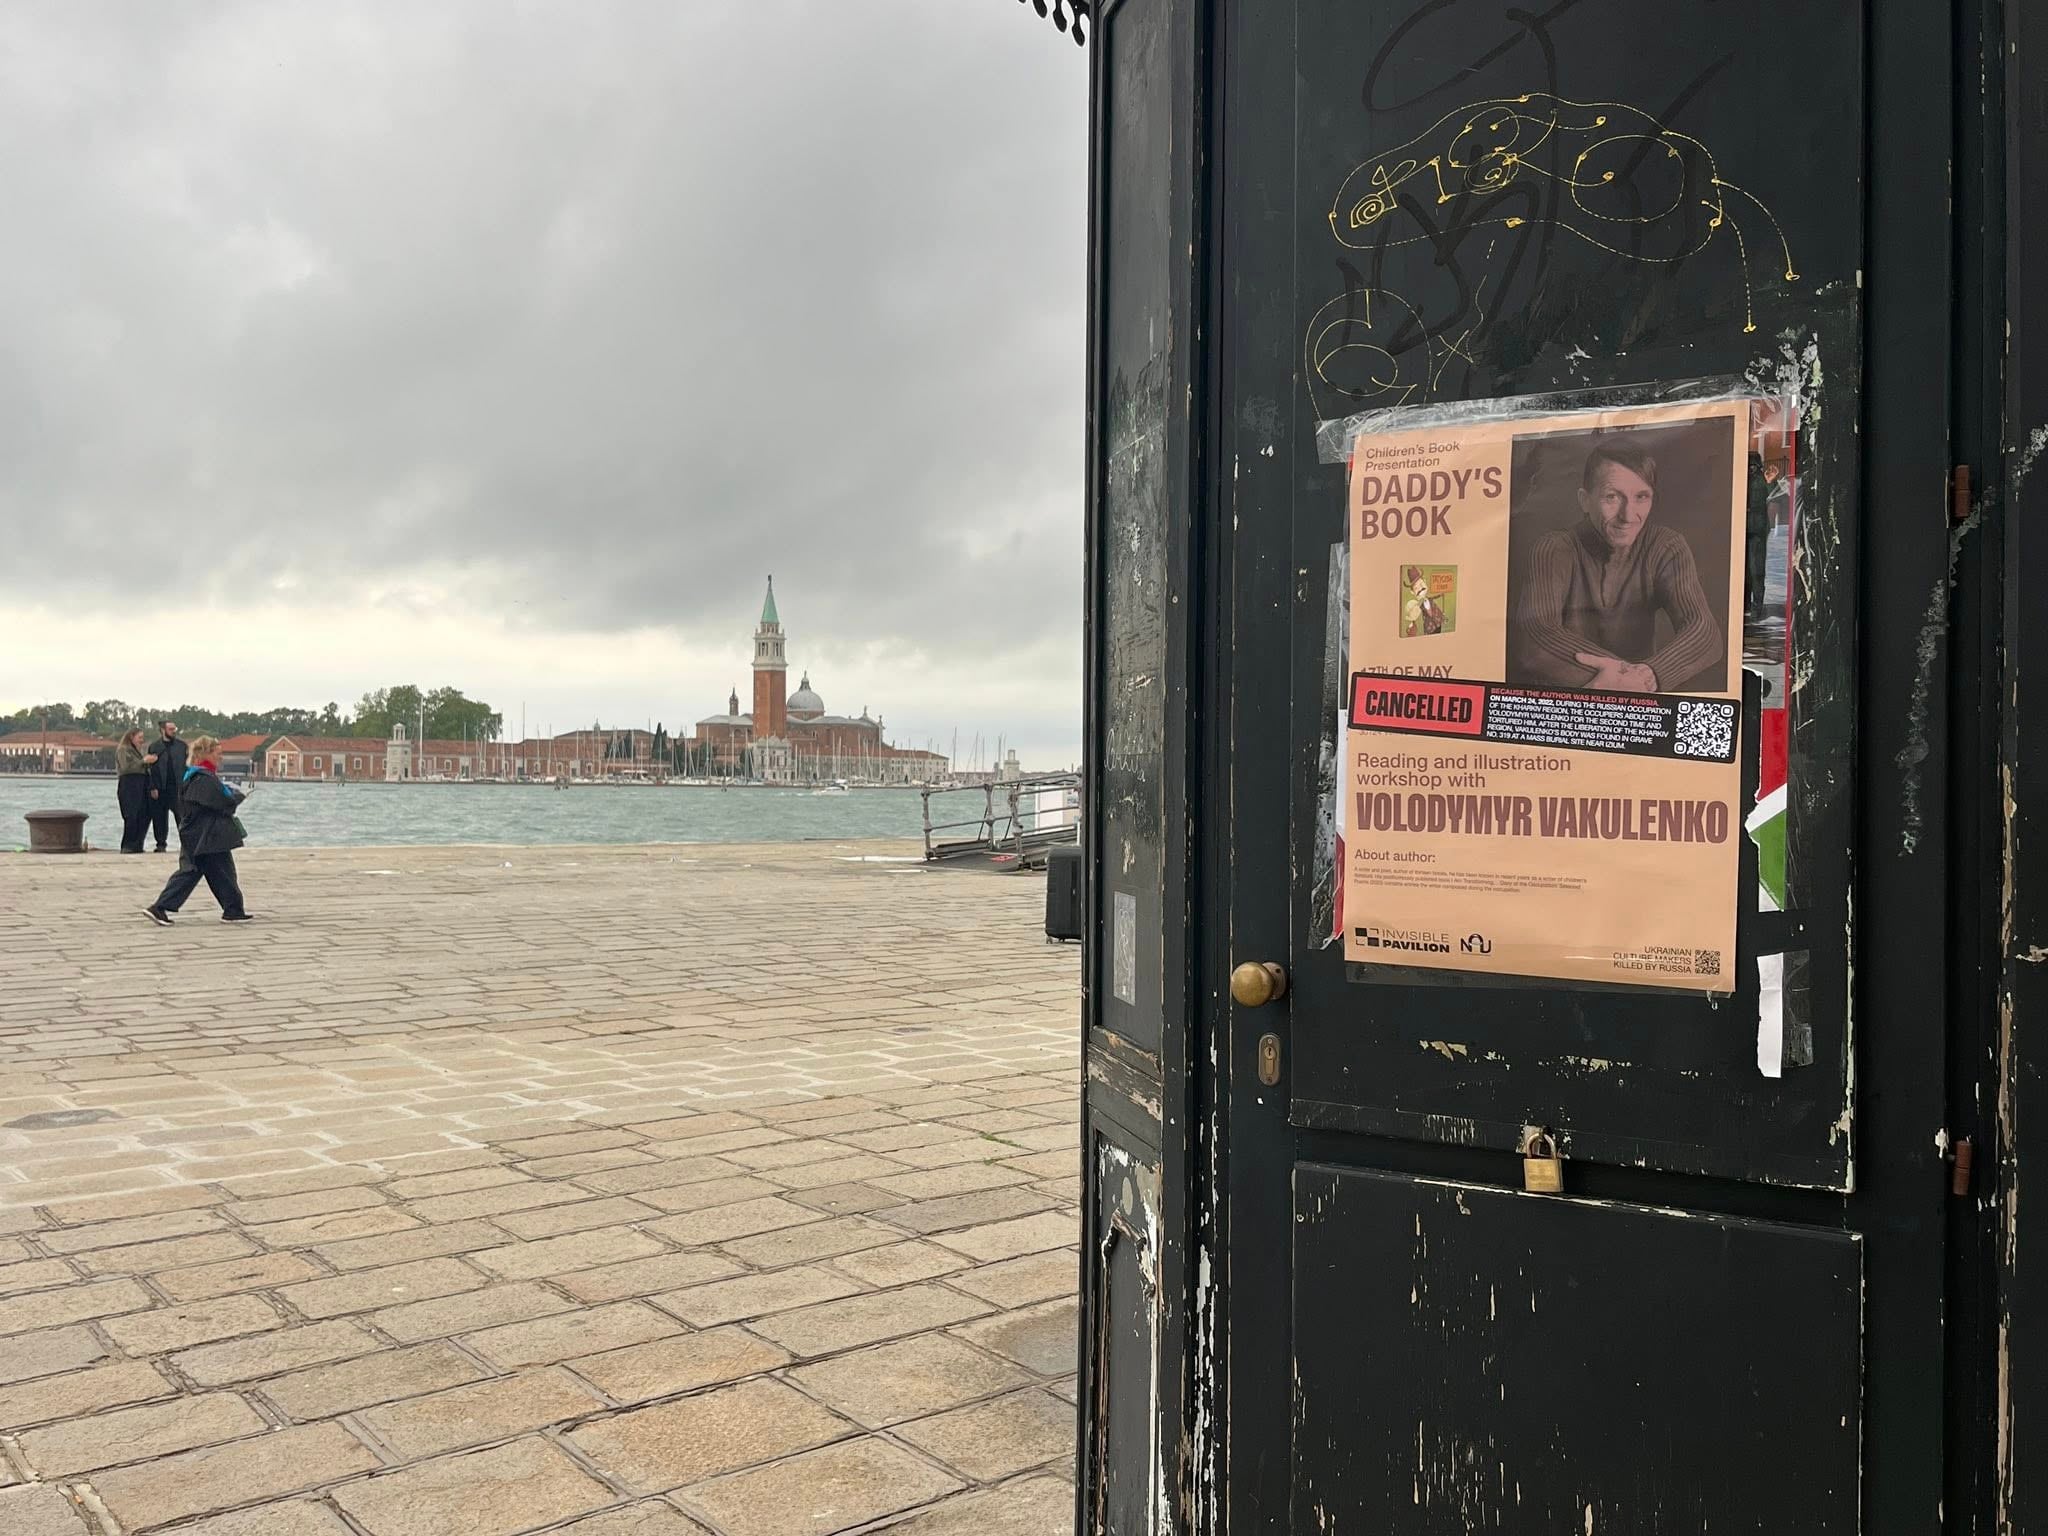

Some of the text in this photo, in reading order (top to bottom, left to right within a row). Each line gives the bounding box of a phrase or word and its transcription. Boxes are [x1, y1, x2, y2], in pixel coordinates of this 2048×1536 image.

[1367, 441, 1460, 458] Children's Book
[1366, 458, 1440, 472] Presentation
[1362, 466, 1502, 506] DADDY'S
[1362, 505, 1452, 539] BOOK
[1419, 666, 1453, 678] MAY
[1491, 688, 1525, 696] BECAUSE
[1541, 692, 1572, 700] AUTHOR
[1630, 698, 1659, 706] RUSSIA.
[1366, 690, 1472, 723] CANCELLED
[1556, 700, 1581, 708] DURING
[1596, 703, 1626, 711] RUSSIAN
[1627, 706, 1671, 715] OCCUPATION
[1489, 709, 1530, 718] VOLODYMYR
[1530, 712, 1569, 722] VAKULENKO
[1600, 718, 1628, 727] SECOND
[1584, 710, 1623, 719] OCCUPIERS
[1624, 712, 1662, 722] ABDUCTED
[1488, 716, 1522, 725] TORTURED
[1538, 720, 1559, 728] AFTER
[1574, 724, 1612, 733] LIBERATION
[1639, 729, 1669, 738] KHARKIV
[1546, 736, 1569, 744] BURIAL
[1571, 738, 1585, 746] SITE
[1597, 733, 1620, 741] FOUND
[1630, 736, 1653, 744] GRAVE
[1358, 753, 1571, 772] Reading and illustration
[1357, 771, 1485, 790] workshop with
[1356, 792, 1728, 844] VOLODYMYR VAKULENKO
[1355, 849, 1436, 863] About author:
[1382, 928, 1449, 943] INVISIBLE
[1383, 940, 1450, 953] PAVILION
[1644, 946, 1692, 956] UKRAINIAN
[1614, 961, 1643, 970] KILLED
[1660, 964, 1692, 973] RUSSIA
[1655, 954, 1692, 965] MAKERS
